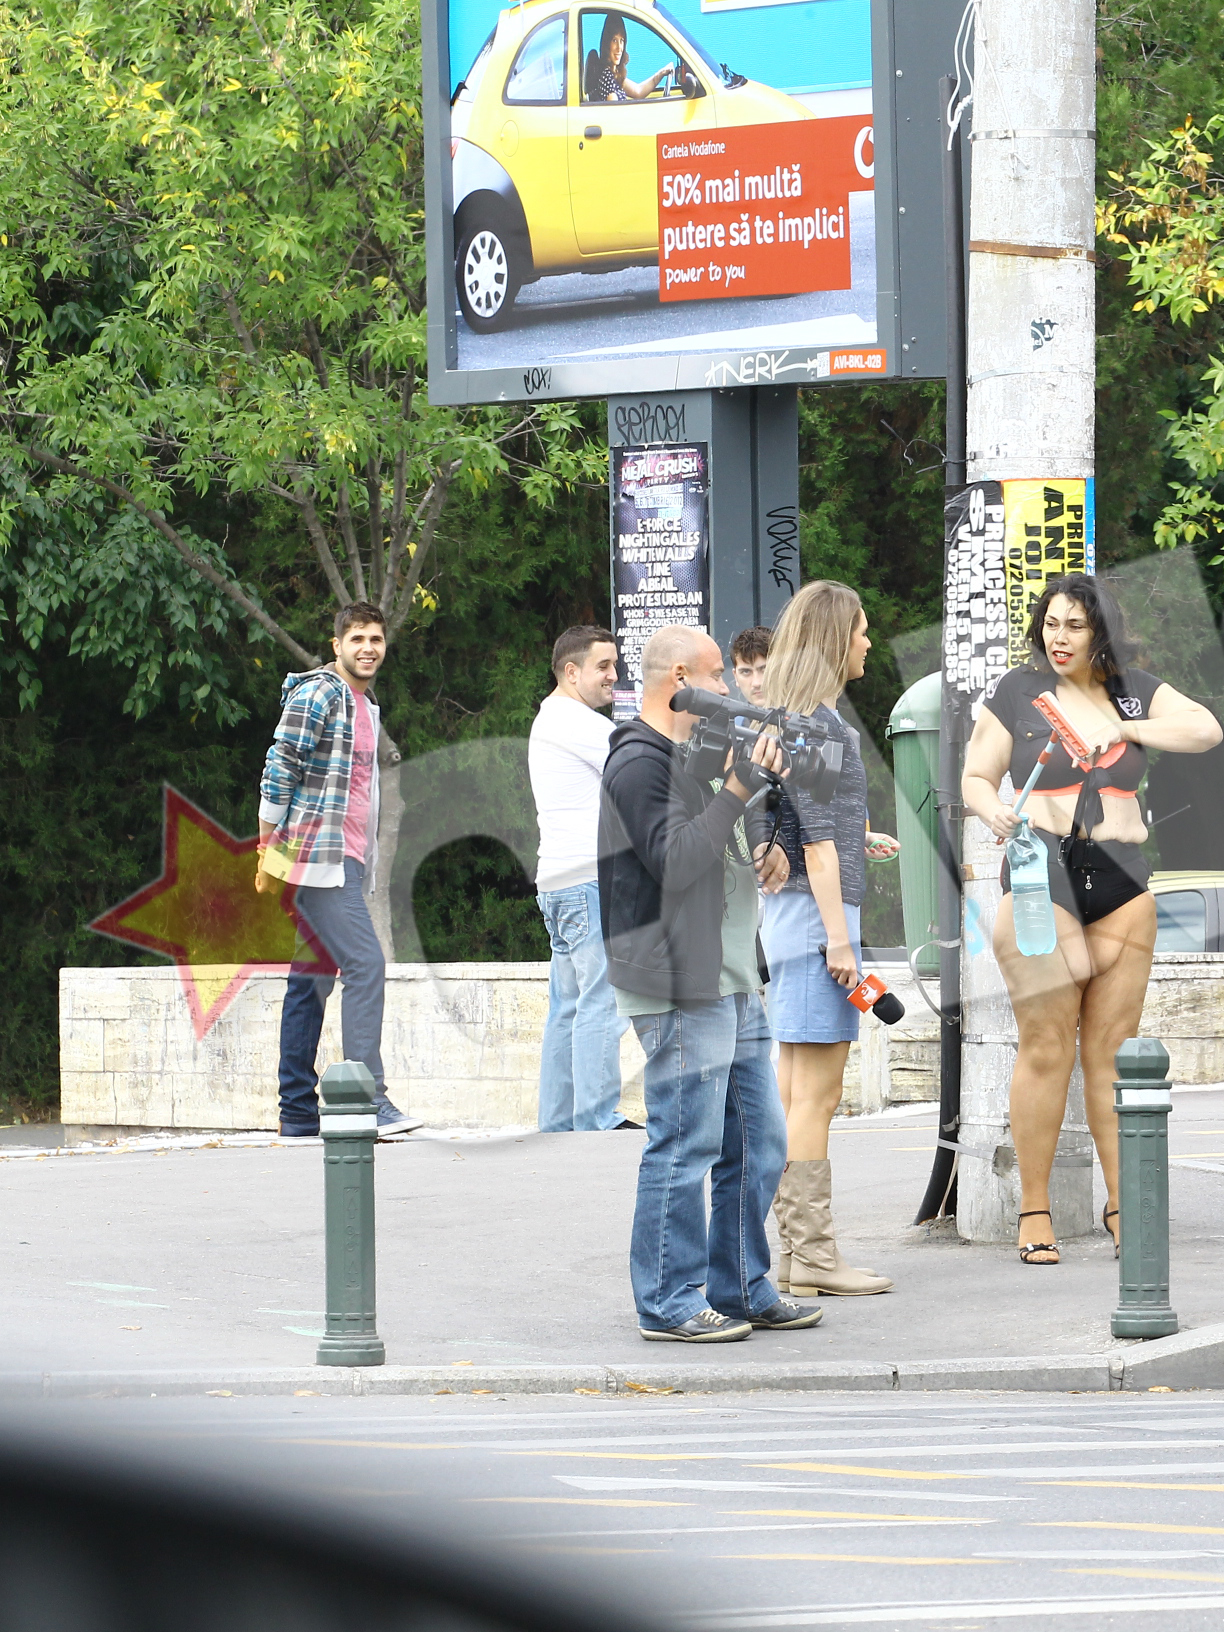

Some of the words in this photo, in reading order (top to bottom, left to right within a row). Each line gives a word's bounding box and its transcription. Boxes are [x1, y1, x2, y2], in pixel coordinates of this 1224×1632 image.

[662, 142, 689, 159] Cartela
[689, 140, 726, 156] Vodafone
[662, 173, 702, 207] 50%
[705, 169, 740, 203] mai
[744, 163, 802, 200] multă
[664, 220, 726, 259] putere
[729, 213, 751, 247] să
[754, 215, 775, 244] te
[778, 206, 845, 249] implici
[665, 265, 705, 290] power
[708, 261, 722, 282] to
[725, 263, 746, 287] you
[833, 354, 882, 370] AVI-BKL-02B
[621, 458, 654, 482] METAL
[655, 456, 699, 477] CRUSH
[957, 523, 971, 612] VINERI
[984, 504, 1008, 640] PRINCESS
[1025, 522, 1042, 581] JOI
[957, 617, 971, 637] 5
[1009, 547, 1024, 668] 072053538
[956, 641, 971, 695] OCT
